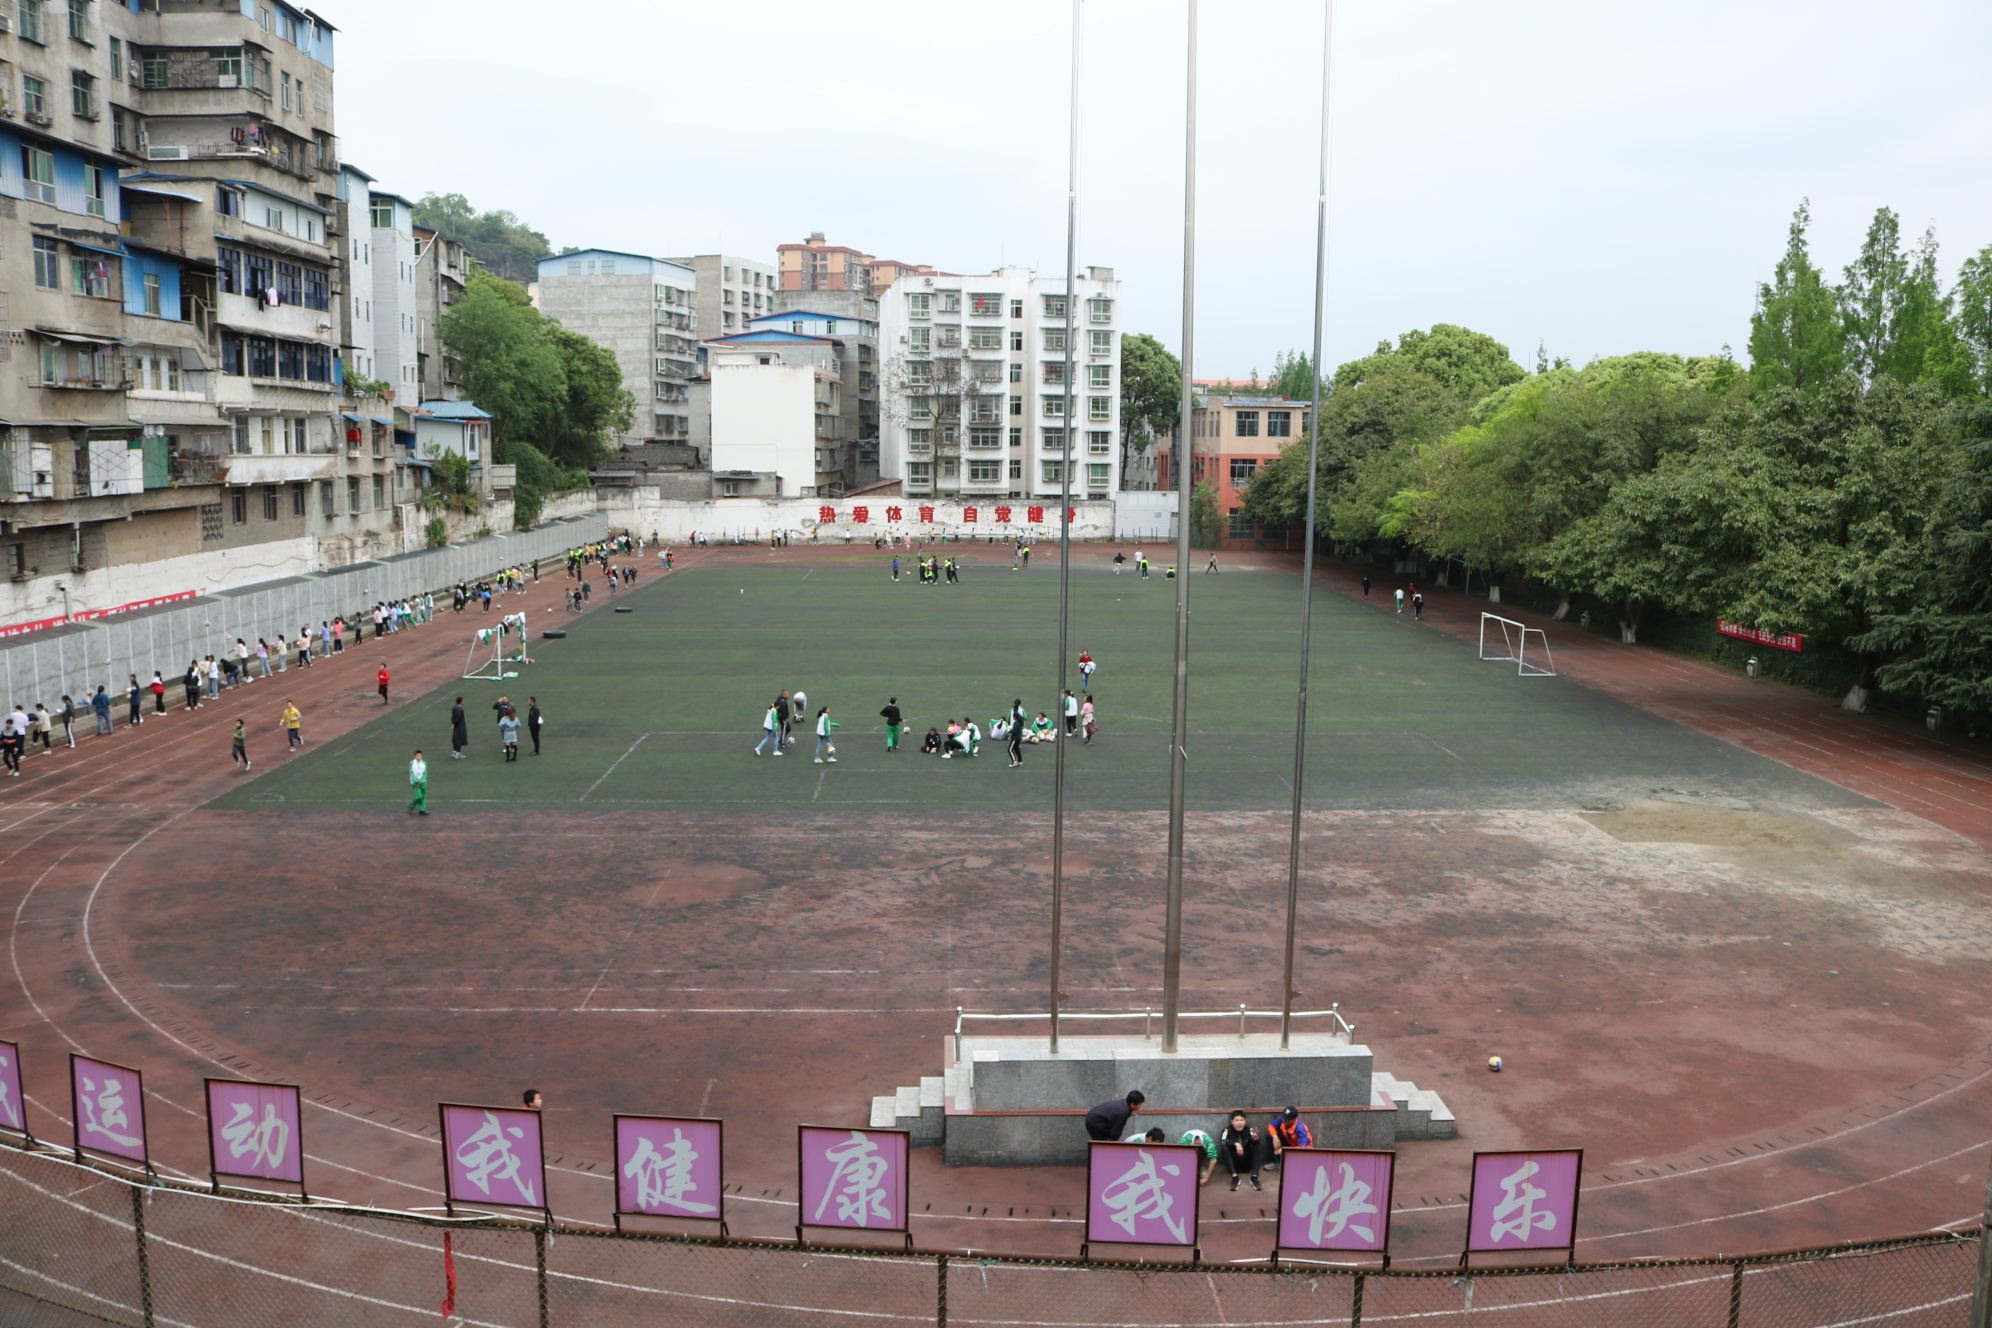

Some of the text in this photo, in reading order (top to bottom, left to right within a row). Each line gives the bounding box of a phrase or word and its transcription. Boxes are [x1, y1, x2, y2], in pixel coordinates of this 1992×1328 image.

[819, 506, 935, 523] 热爱体育
[82, 1077, 143, 1147] 运
[221, 1102, 289, 1169] 动
[456, 1111, 535, 1206] 我
[623, 1128, 717, 1212] 健
[814, 1130, 892, 1227] 康
[1101, 1148, 1187, 1244] 我
[1292, 1162, 1378, 1245] 快
[1490, 1161, 1557, 1243] 乐
